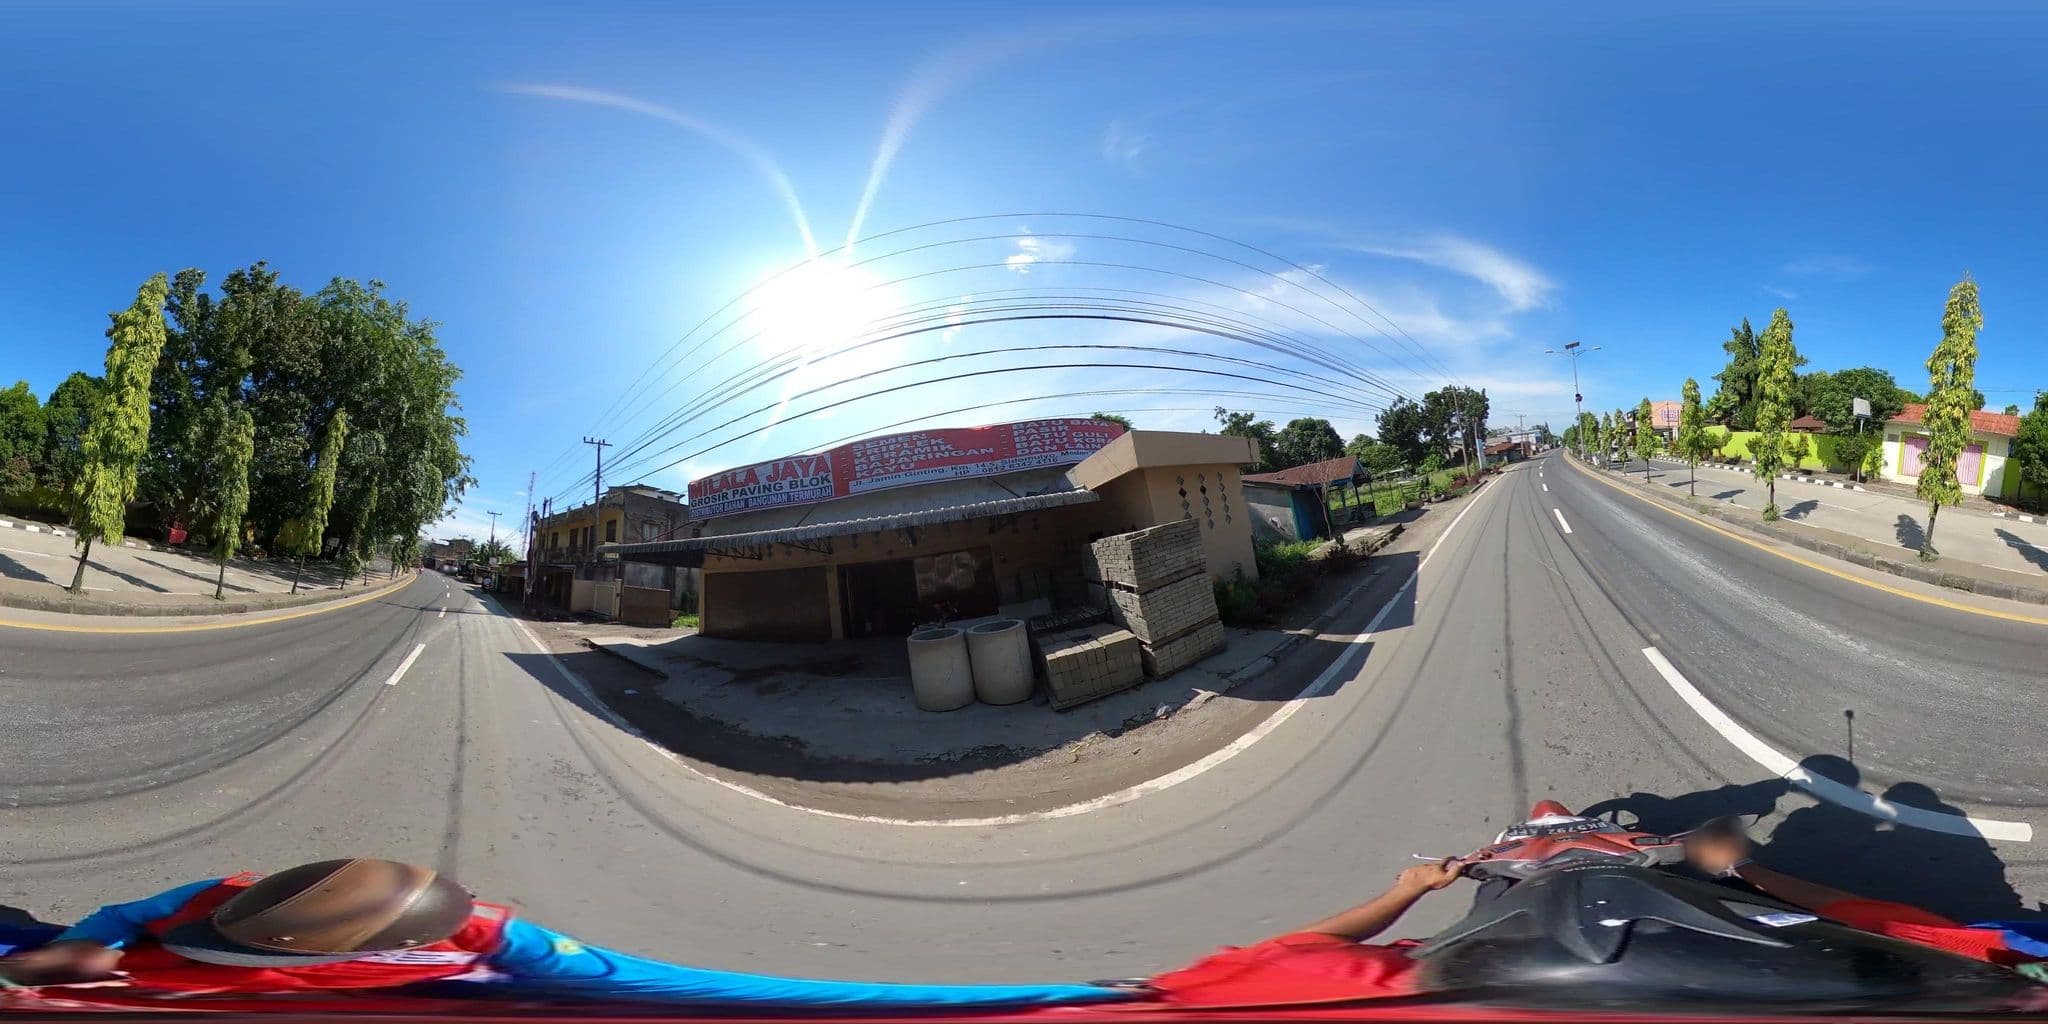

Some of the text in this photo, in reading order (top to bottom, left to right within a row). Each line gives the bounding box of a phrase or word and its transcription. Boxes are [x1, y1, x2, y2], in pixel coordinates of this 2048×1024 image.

[1012, 420, 1064, 430] BATU
[1013, 425, 1069, 436] PASIR
[853, 432, 927, 450] SEMEN
[1014, 431, 1067, 442] BATU
[1015, 437, 1068, 448] BATU
[853, 438, 945, 458] TRIPLEK
[855, 443, 955, 465] KERAMIK
[1017, 445, 1058, 456] DAN
[856, 447, 994, 471] BAJARINGAN
[690, 454, 832, 500] MILALA JAYA
[856, 461, 915, 479] KAYU
[868, 474, 901, 484] Jamin
[691, 473, 832, 509] GROSIR PAVING BLOK
[690, 485, 833, 518] DISTRIBUTOR BAHAN BANGUNAN TERMURAH
